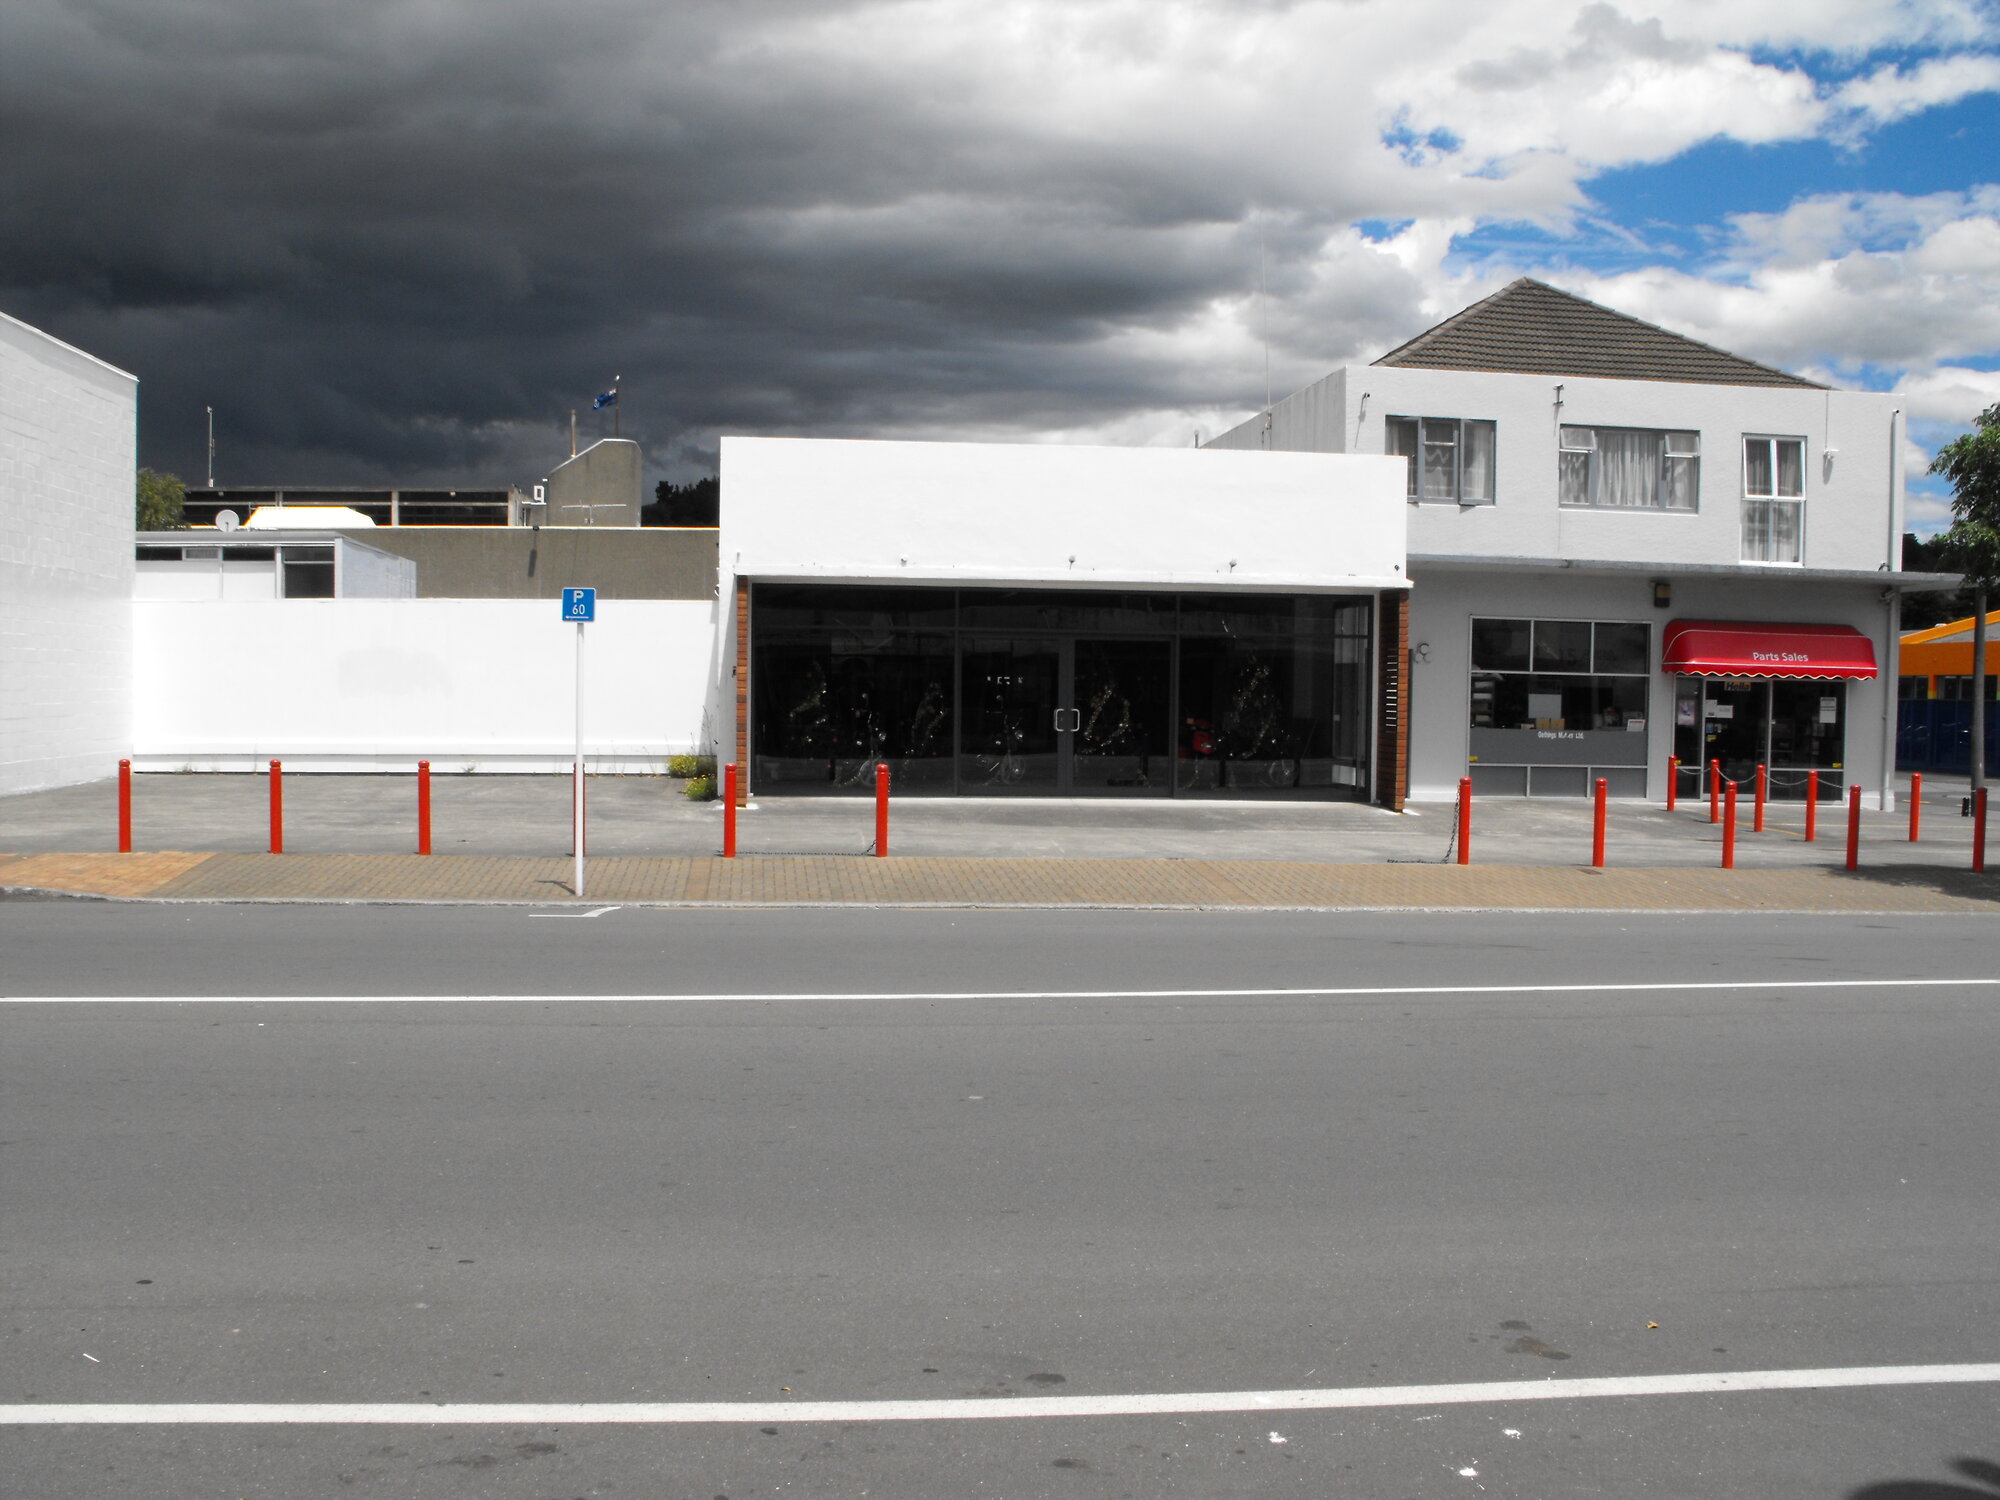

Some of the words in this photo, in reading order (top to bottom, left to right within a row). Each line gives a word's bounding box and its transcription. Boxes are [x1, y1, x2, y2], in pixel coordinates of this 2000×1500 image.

[573, 590, 585, 603] P
[572, 604, 586, 615] 60
[1752, 652, 1780, 661] Parts
[1781, 652, 1809, 662] Sales
